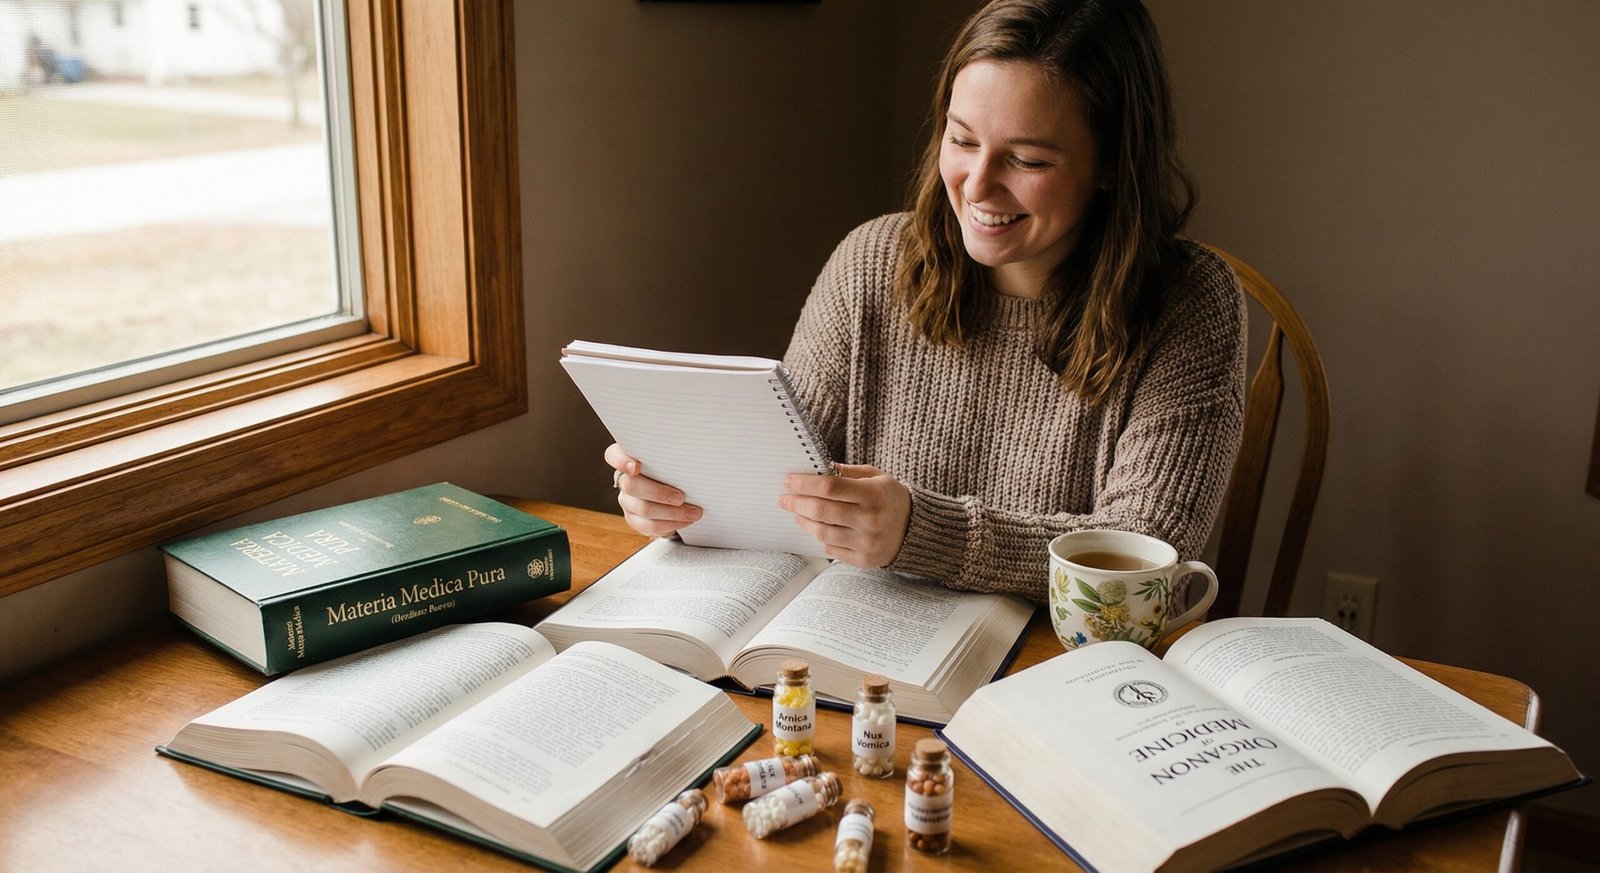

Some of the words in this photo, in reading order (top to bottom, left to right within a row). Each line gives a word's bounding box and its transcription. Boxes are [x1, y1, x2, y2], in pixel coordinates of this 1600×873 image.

[262, 531, 338, 568] MEDICA
[304, 529, 360, 555] PURA
[326, 593, 397, 626] Materia
[400, 577, 464, 606] Medica
[467, 567, 506, 588] Pura
[775, 721, 812, 732] Montana
[778, 712, 808, 722] Arnica
[857, 738, 890, 749] Vomica
[863, 730, 884, 740] Nux
[1129, 718, 1251, 763] MEDICINE
[1151, 736, 1278, 785] ORGANON
[1226, 758, 1265, 775] THE
